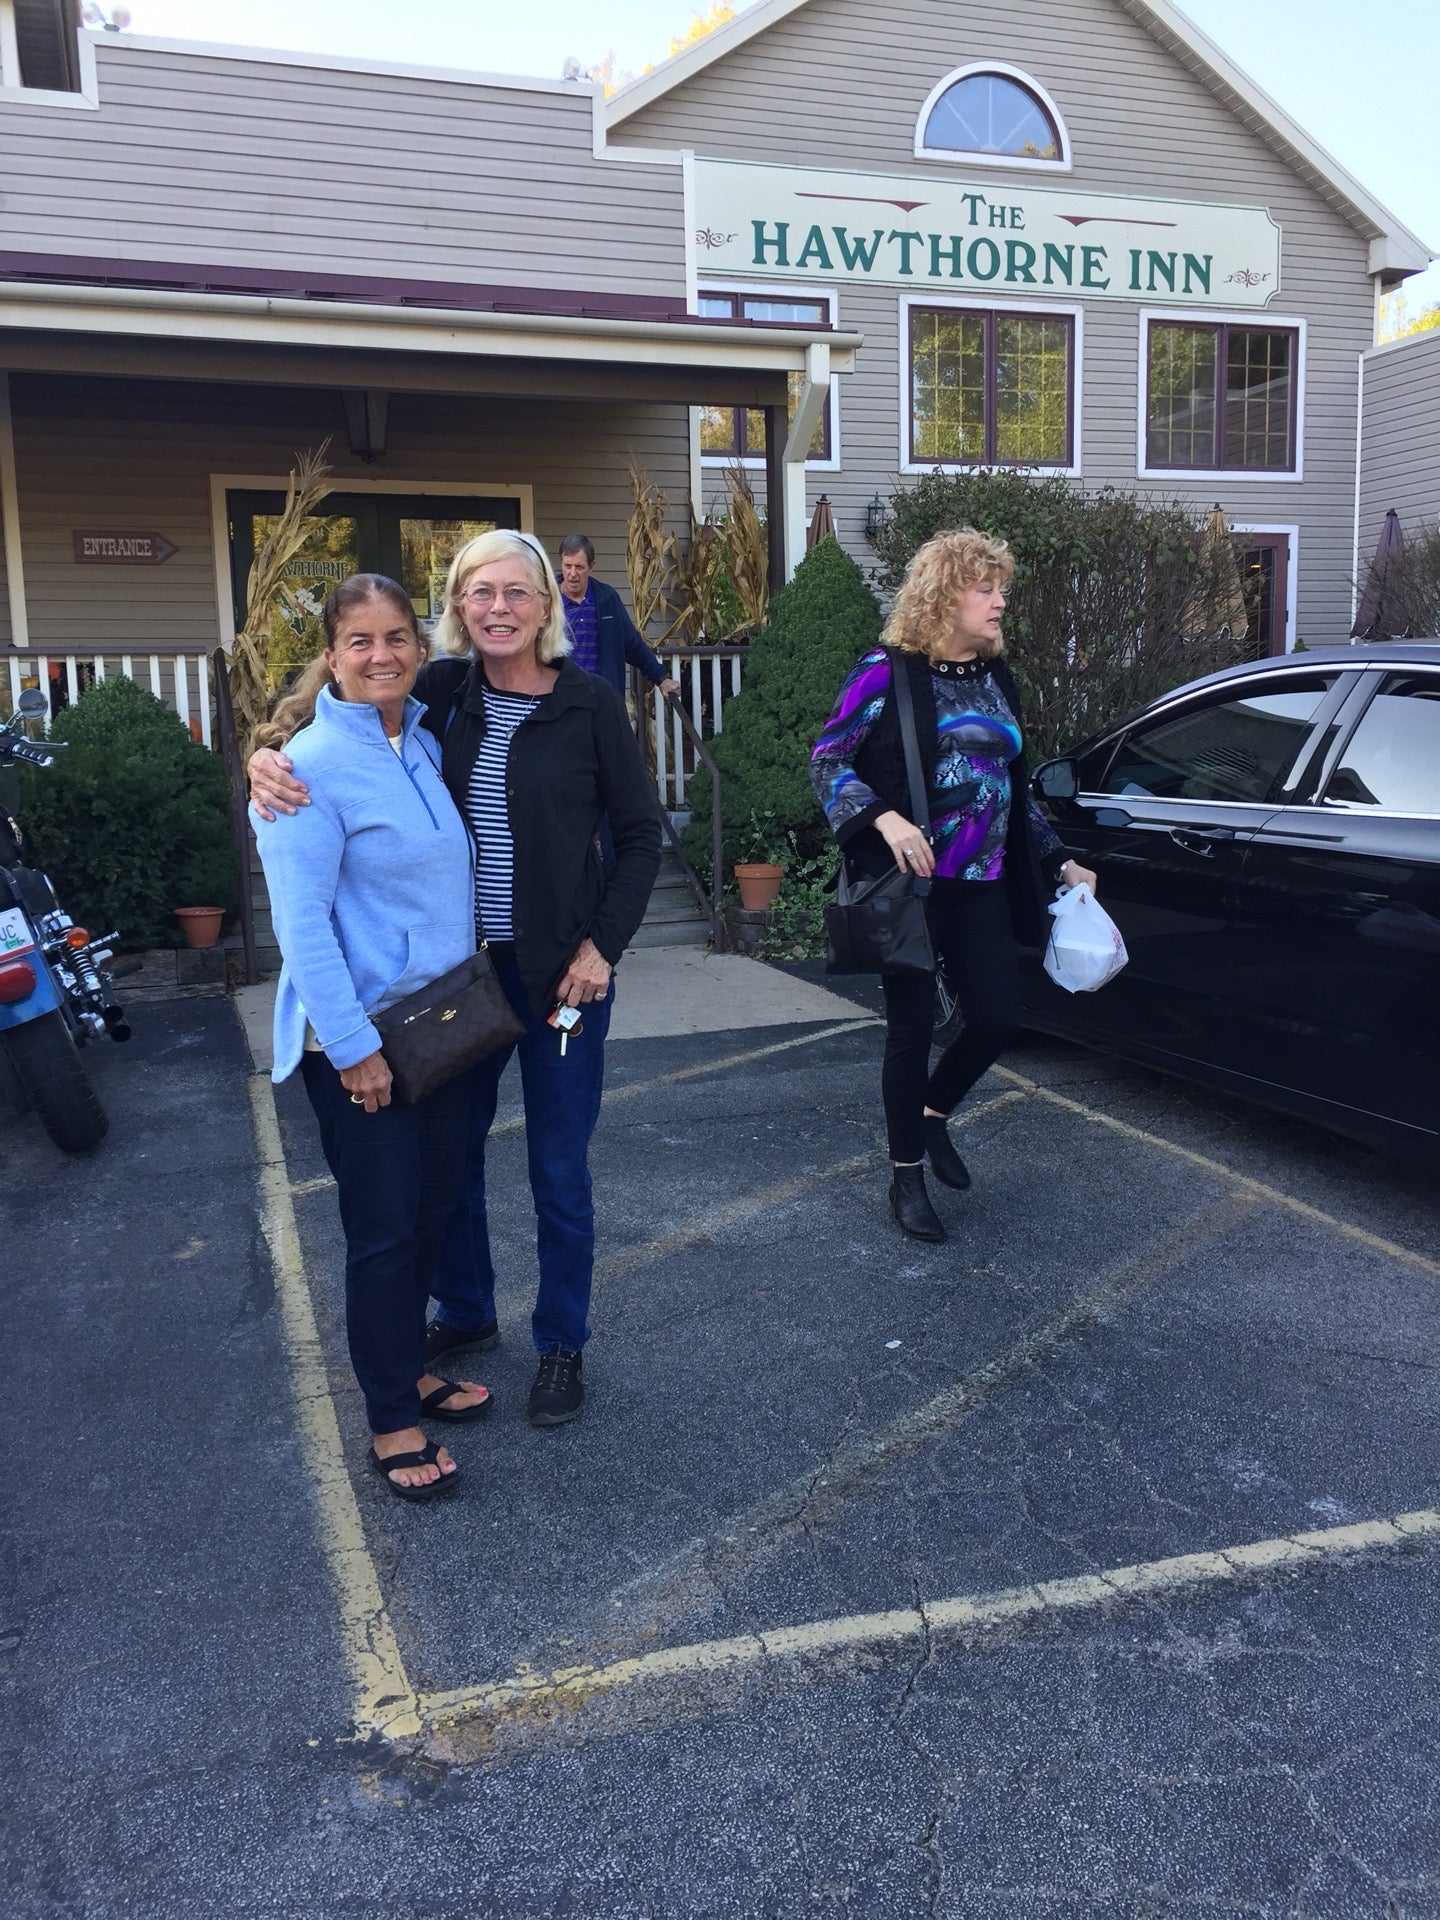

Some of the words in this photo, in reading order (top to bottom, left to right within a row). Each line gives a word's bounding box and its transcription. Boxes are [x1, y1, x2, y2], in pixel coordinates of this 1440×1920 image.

[750, 219, 1111, 291] HAWTHORNE
[1128, 248, 1214, 295] INN
[82, 537, 152, 556] ENTRANCE
[280, 558, 351, 581] AWTHORNE
